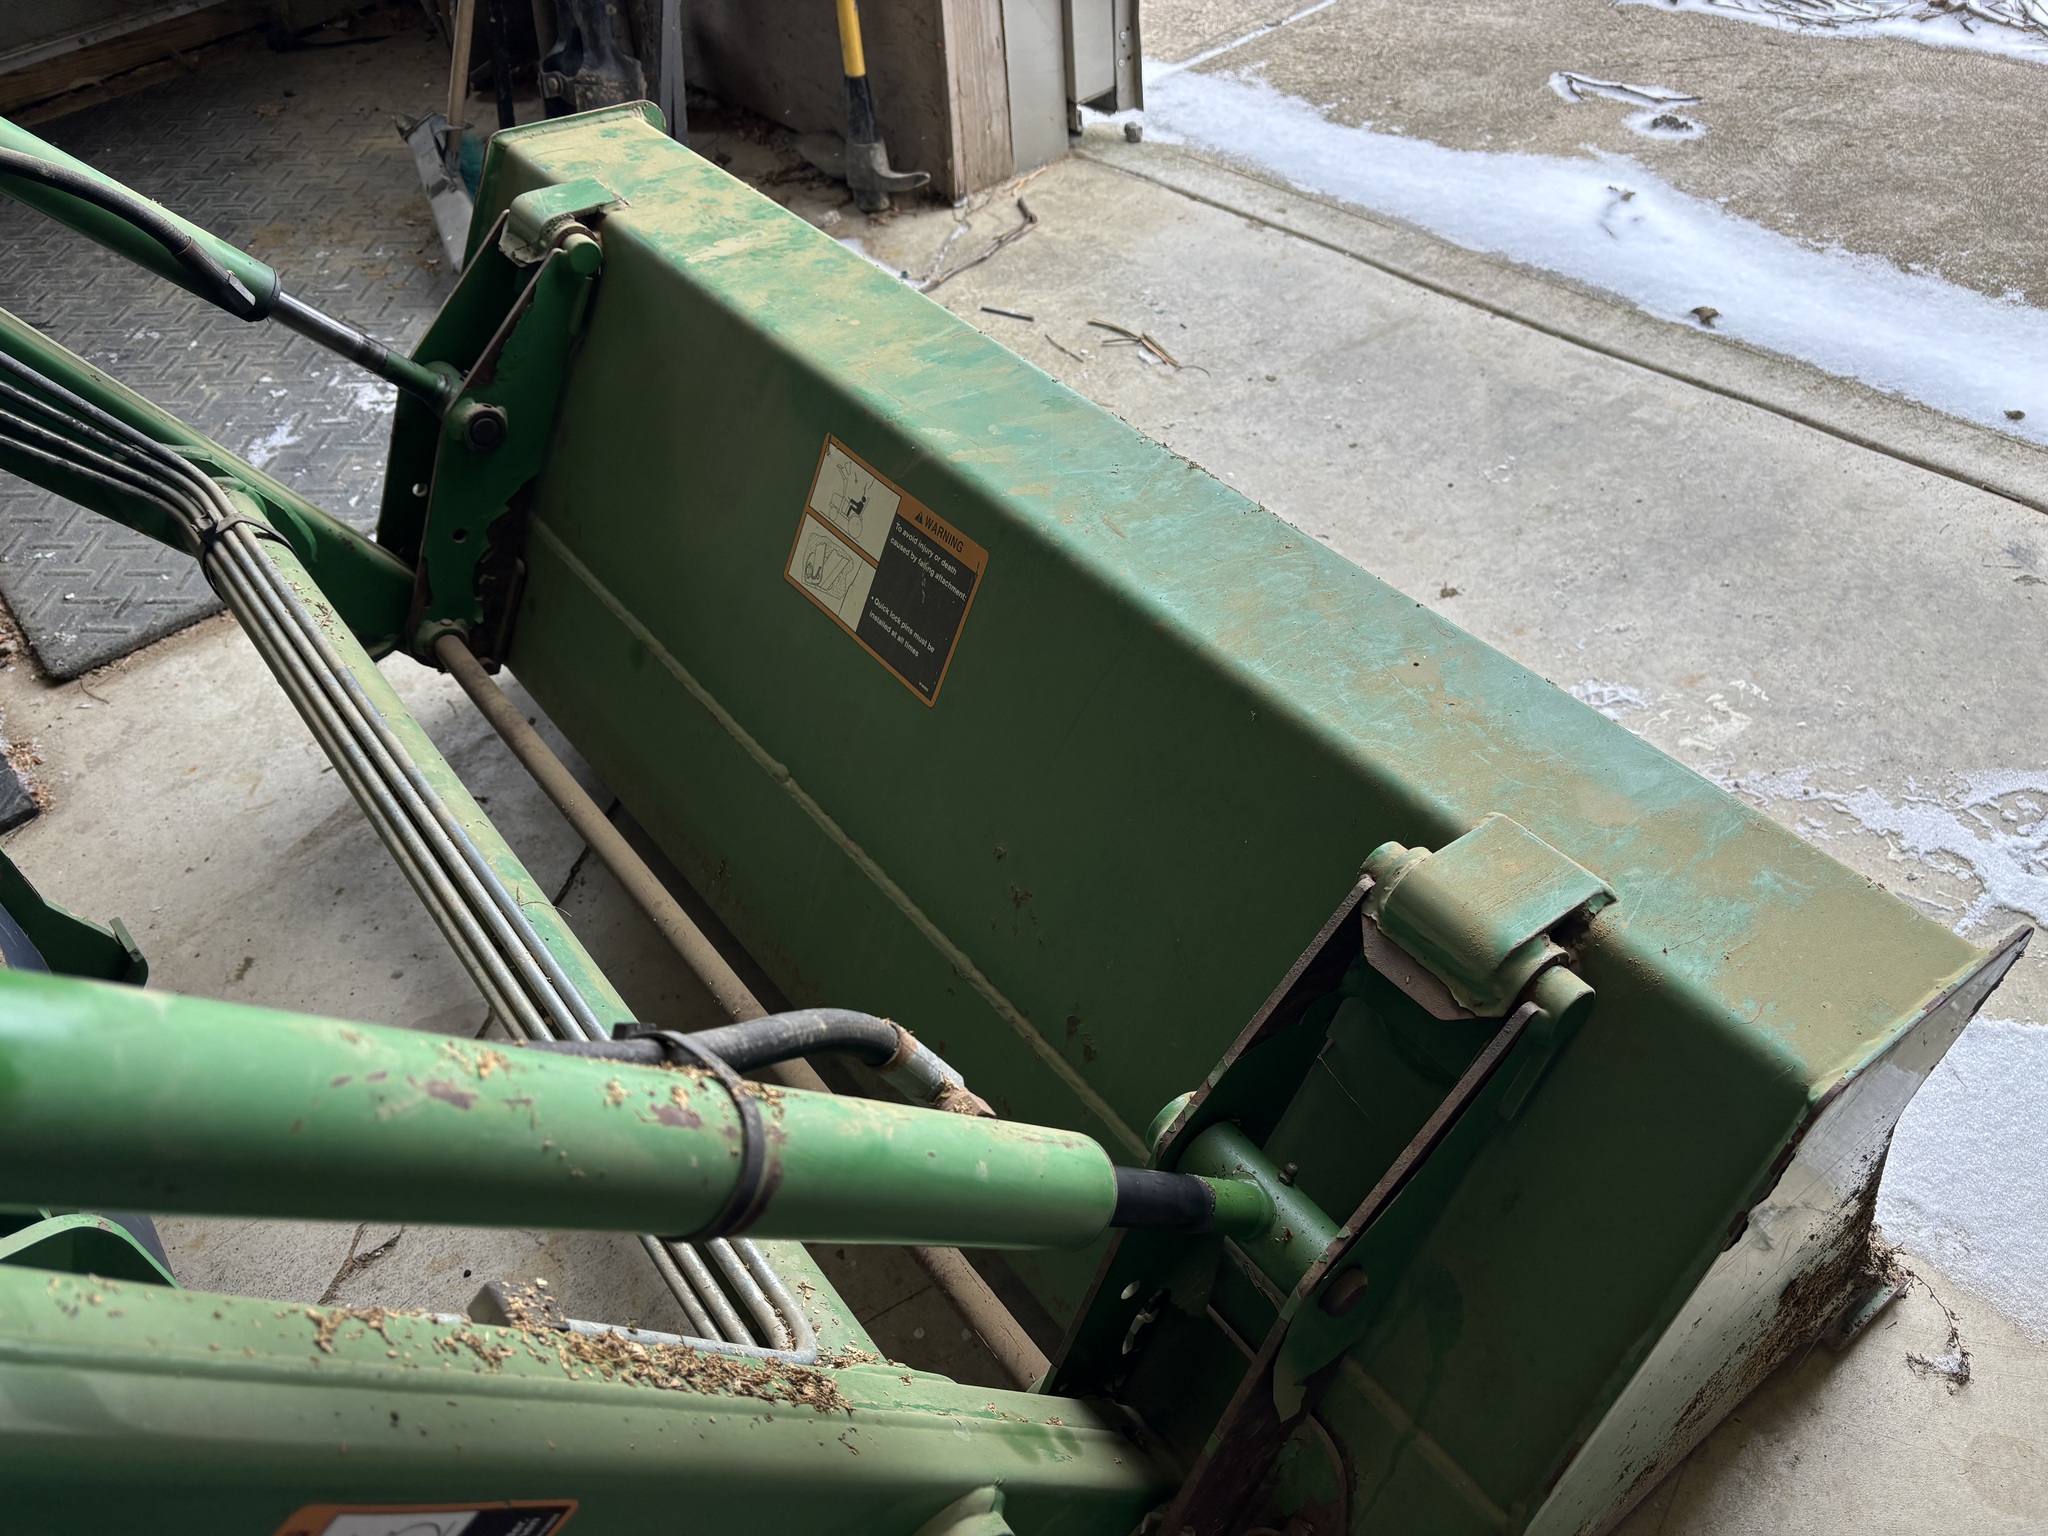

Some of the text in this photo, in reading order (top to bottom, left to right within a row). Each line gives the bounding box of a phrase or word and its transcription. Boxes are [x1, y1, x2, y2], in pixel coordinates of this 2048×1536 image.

[895, 522, 957, 575] To avoid injury or death
[925, 516, 963, 553] WARNING
[890, 537, 967, 602] caused by falling attachment:
[869, 610, 919, 657] installed at all times
[874, 597, 935, 653] Quick lock pins must be
